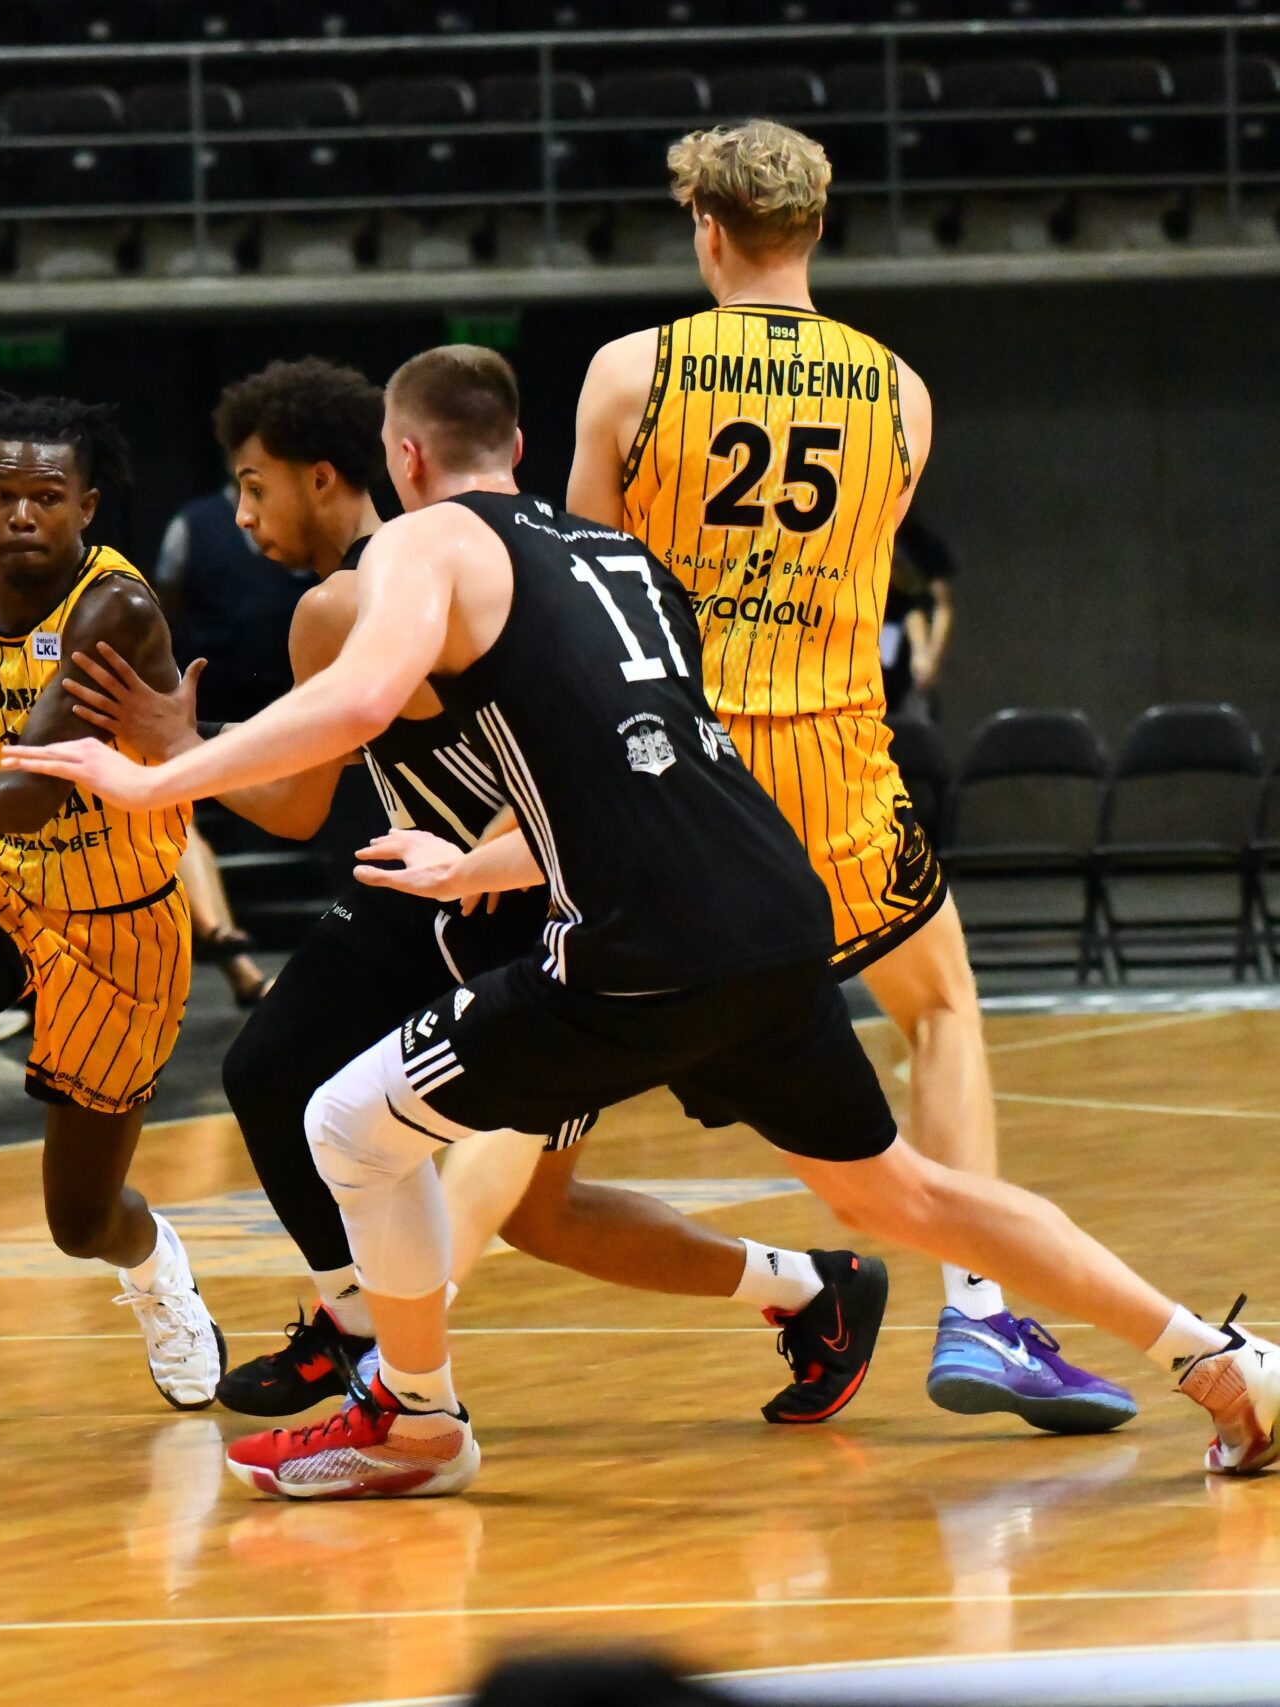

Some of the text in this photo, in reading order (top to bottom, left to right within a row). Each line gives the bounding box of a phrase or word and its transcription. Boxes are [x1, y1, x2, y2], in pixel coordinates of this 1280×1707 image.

[769, 326, 797, 339] 1994
[679, 353, 881, 403] ROMANČENKO
[701, 419, 841, 535] 25
[664, 548, 738, 573] ŠIAULIŲ
[570, 553, 690, 683] 17
[36, 644, 58, 656] LKL
[69, 827, 113, 852] BET
